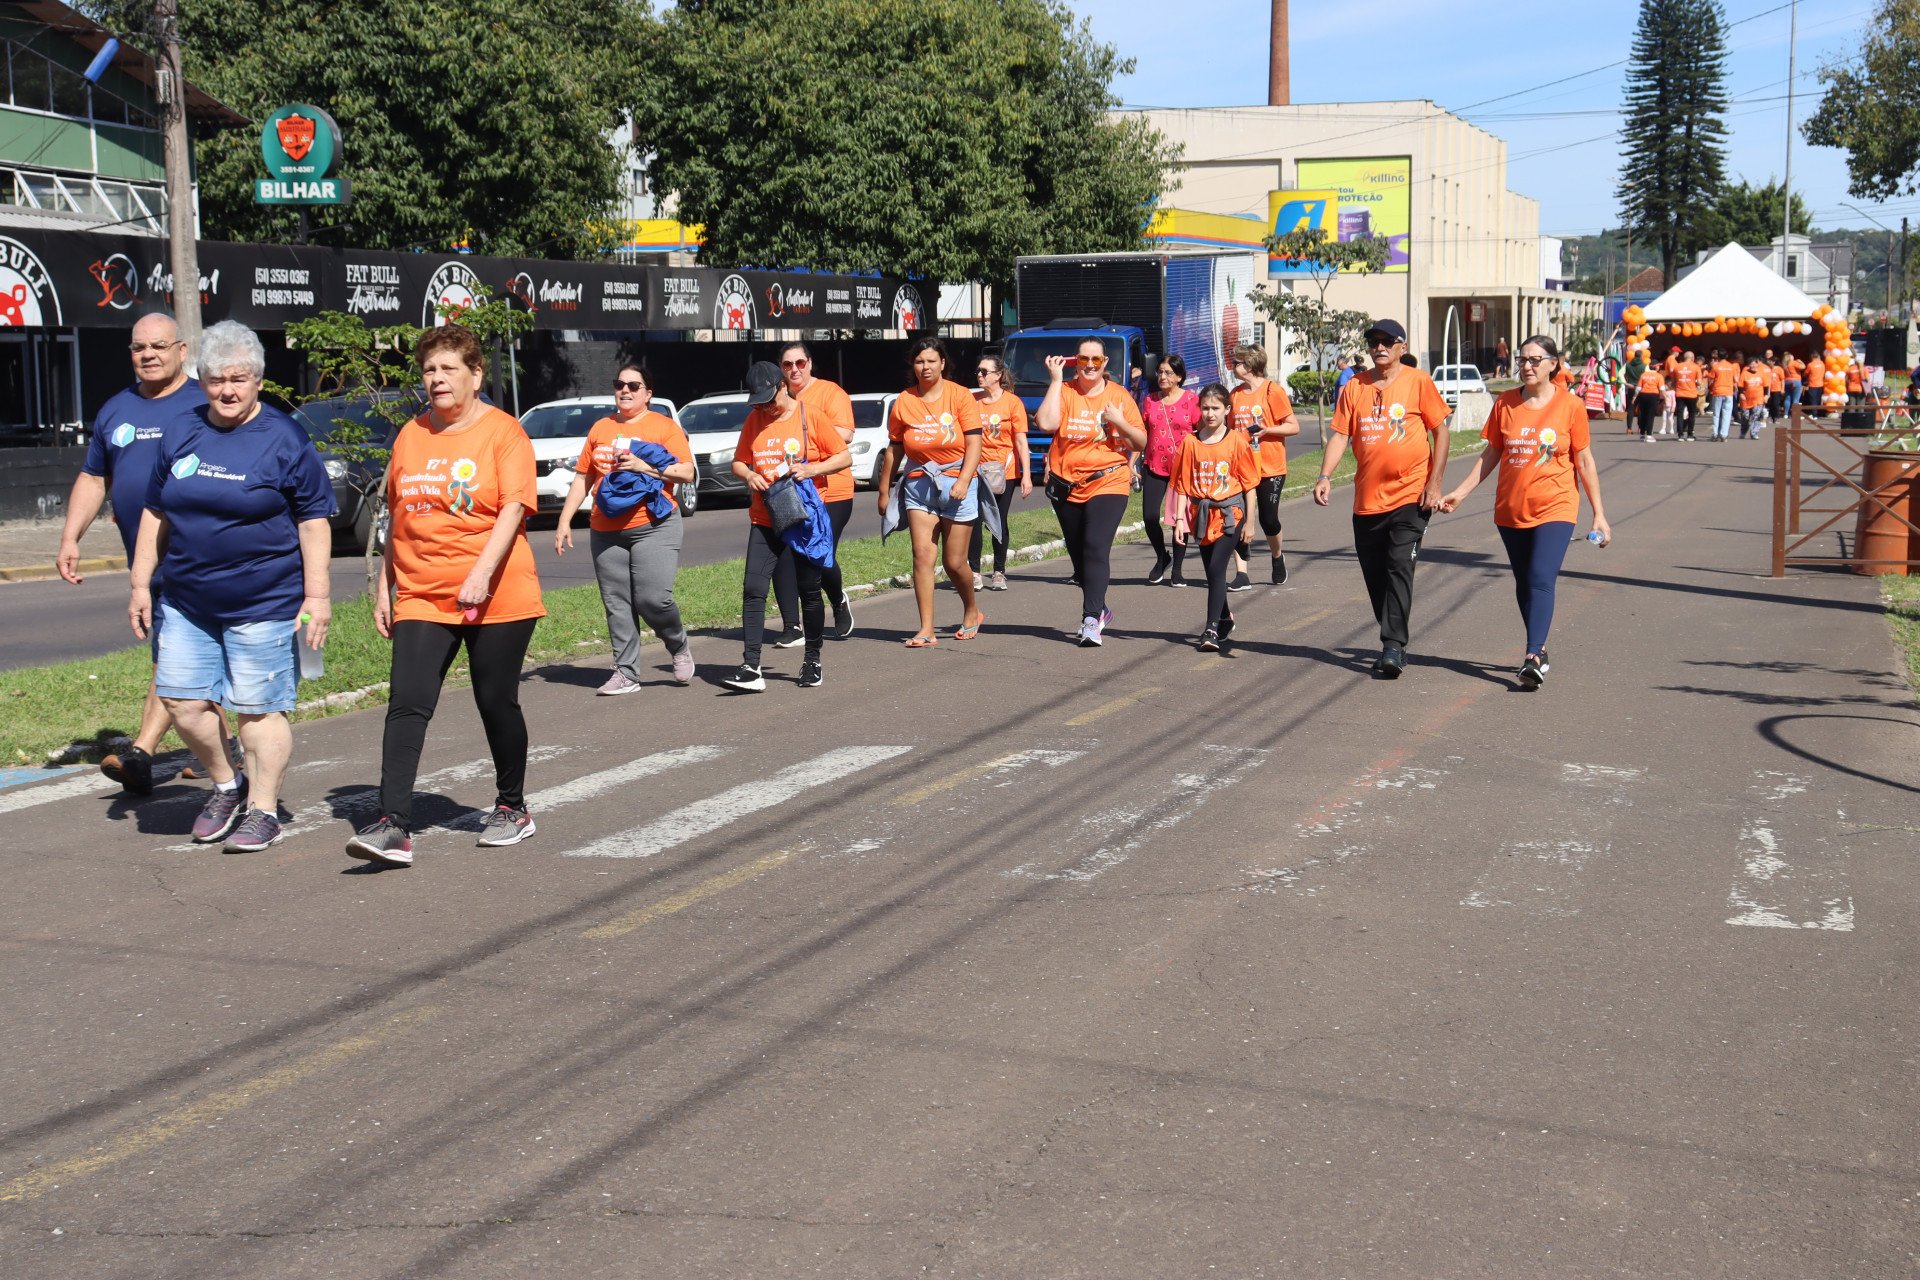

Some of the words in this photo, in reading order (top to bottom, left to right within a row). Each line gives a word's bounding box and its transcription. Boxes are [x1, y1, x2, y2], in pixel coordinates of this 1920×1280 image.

[260, 181, 336, 199] BILHAR
[1338, 192, 1383, 203] ROTEÇÃO
[270, 268, 289, 284] 3551
[289, 269, 310, 285] 0367
[345, 264, 369, 283] FAT
[370, 265, 400, 284] BULL
[427, 268, 450, 307] FAT
[663, 277, 680, 293] FAT
[679, 278, 700, 293] BULL
[266, 289, 292, 305] 99879
[346, 284, 401, 314] Australia
[717, 280, 732, 310] FAT
[732, 278, 752, 311] BULL
[419, 484, 441, 496] Vida
